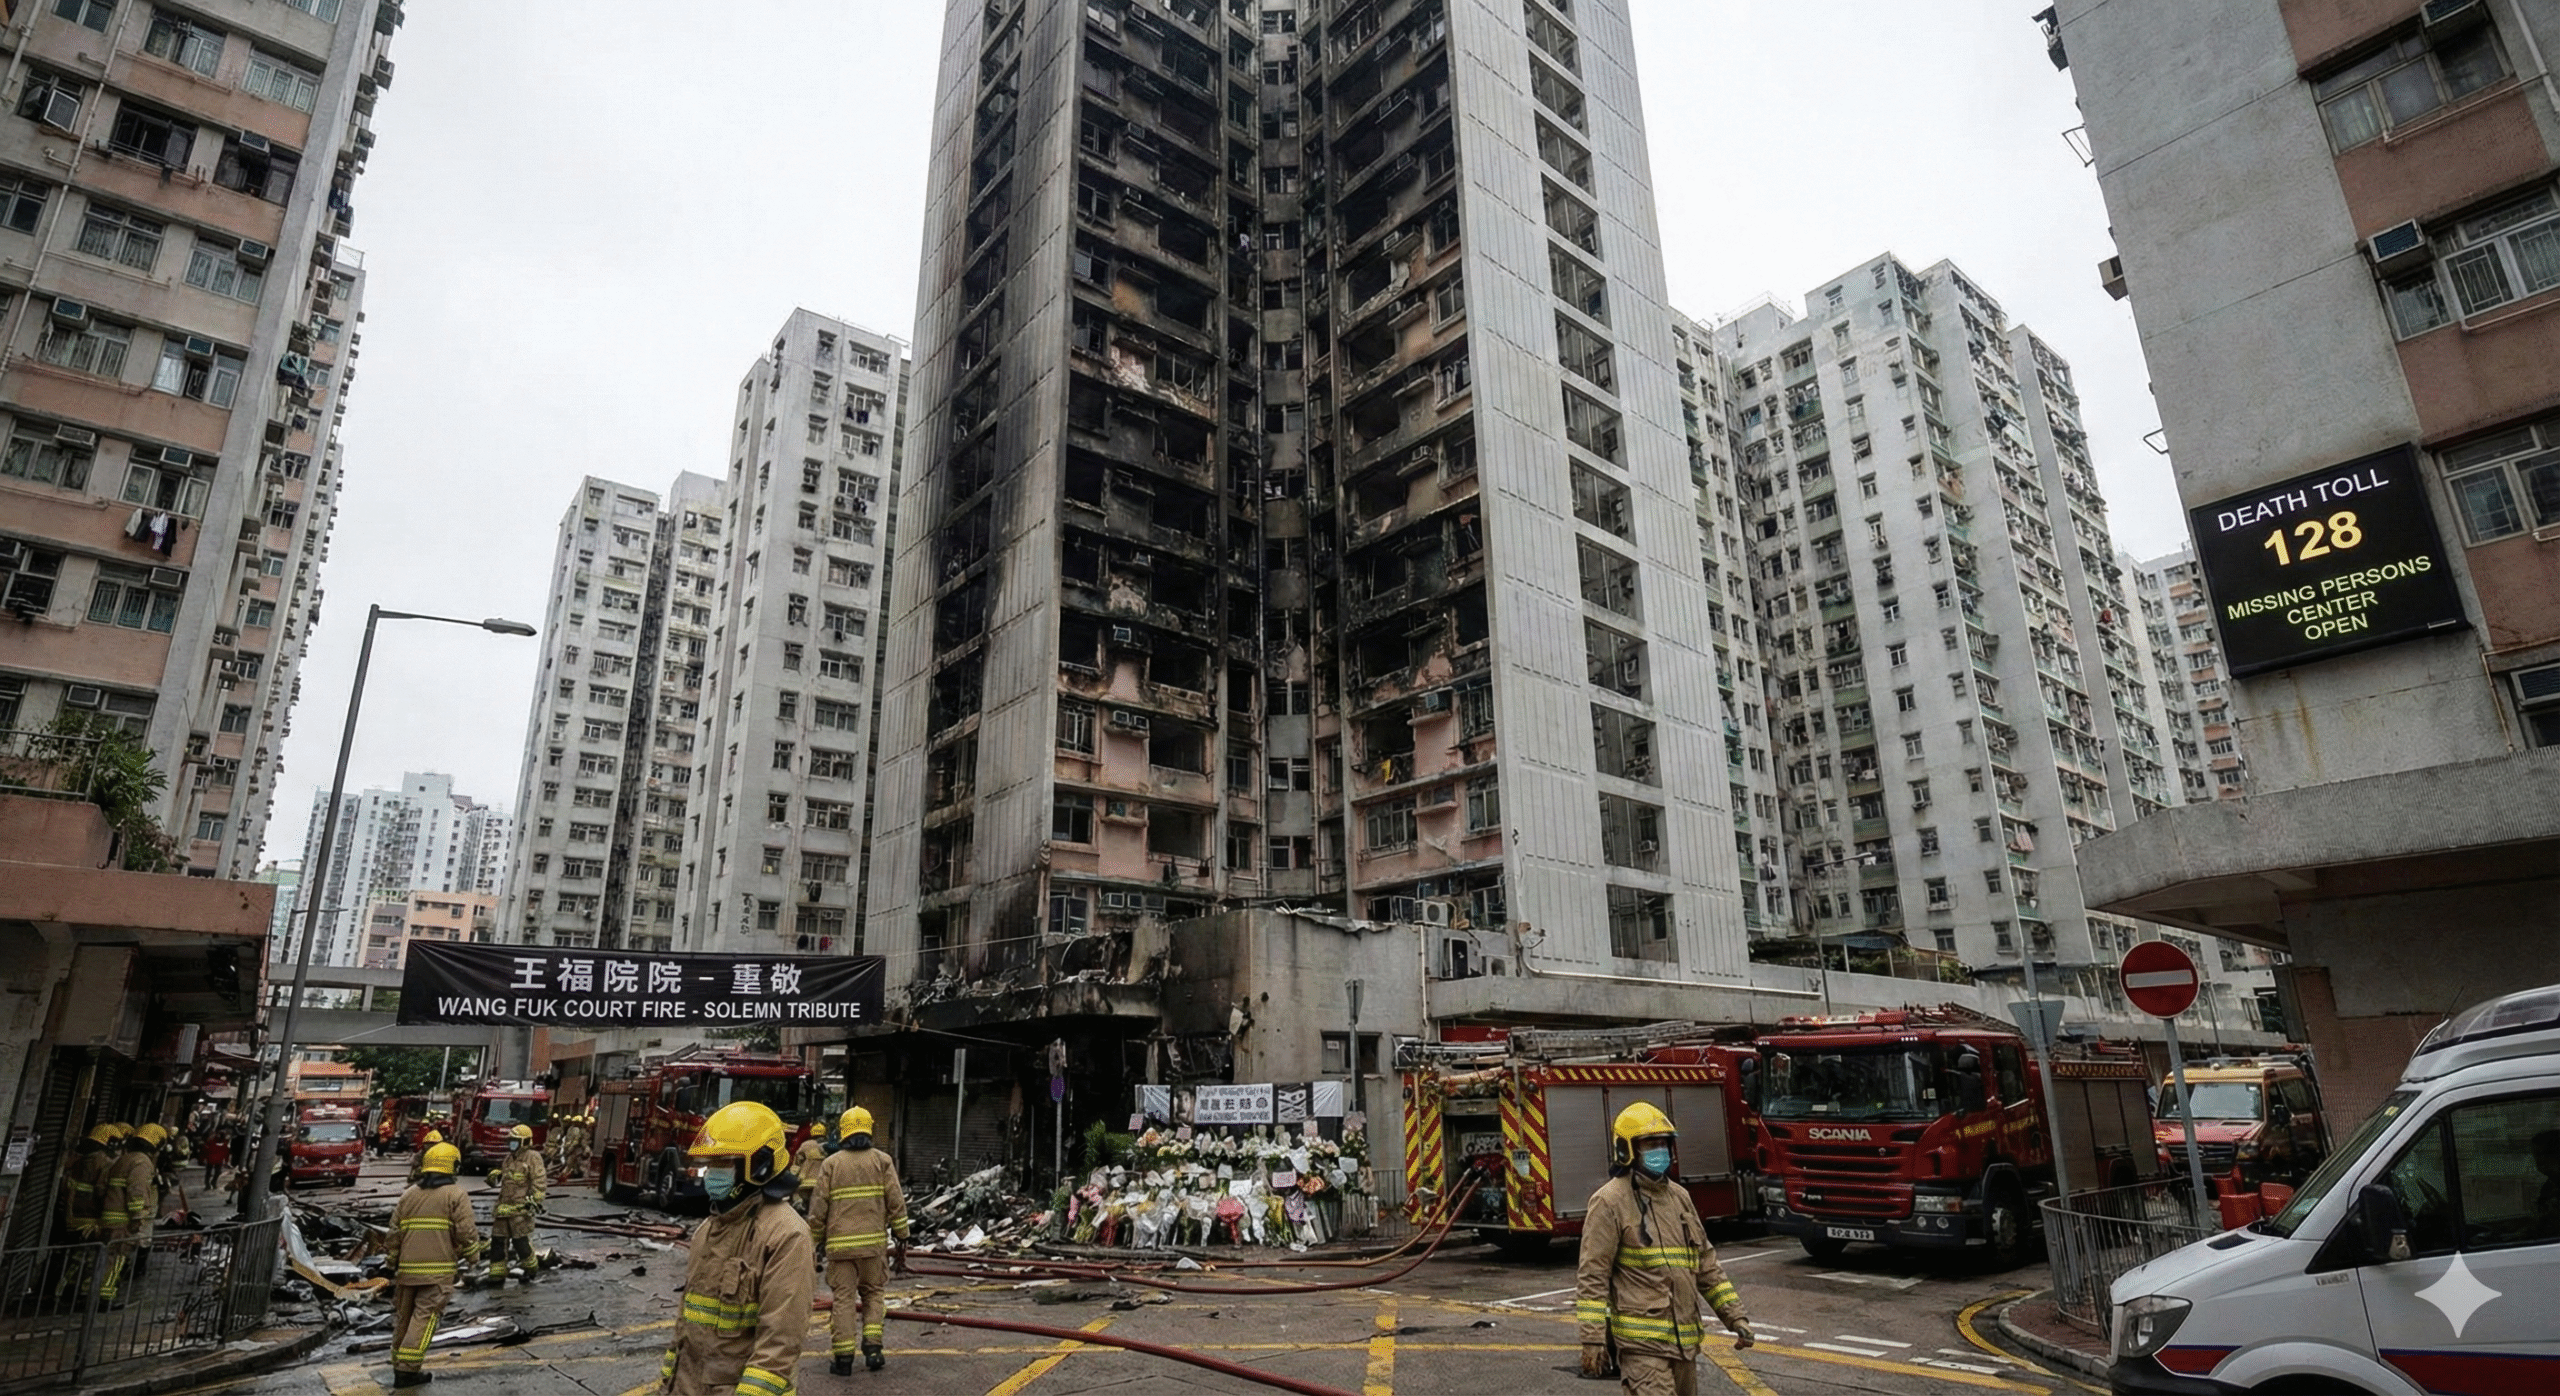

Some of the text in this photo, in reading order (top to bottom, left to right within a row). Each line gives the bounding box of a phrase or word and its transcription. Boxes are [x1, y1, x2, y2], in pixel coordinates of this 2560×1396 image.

[2218, 468, 2389, 532] DEATH TOLL
[2264, 510, 2362, 566] 128
[2227, 555, 2432, 620] MISSING PERSONS
[2287, 590, 2379, 625] CENTER
[2304, 613, 2369, 640] OPEN
[510, 957, 682, 993] 王福院院
[438, 997, 507, 1016] WANG
[514, 998, 559, 1017] FUK
[564, 1000, 636, 1018] COURT
[642, 1001, 686, 1019] FIRE
[704, 1002, 781, 1019] SOLEMN
[787, 1002, 861, 1019] TRIBUTE
[1809, 1128, 1872, 1141] SCANIA
